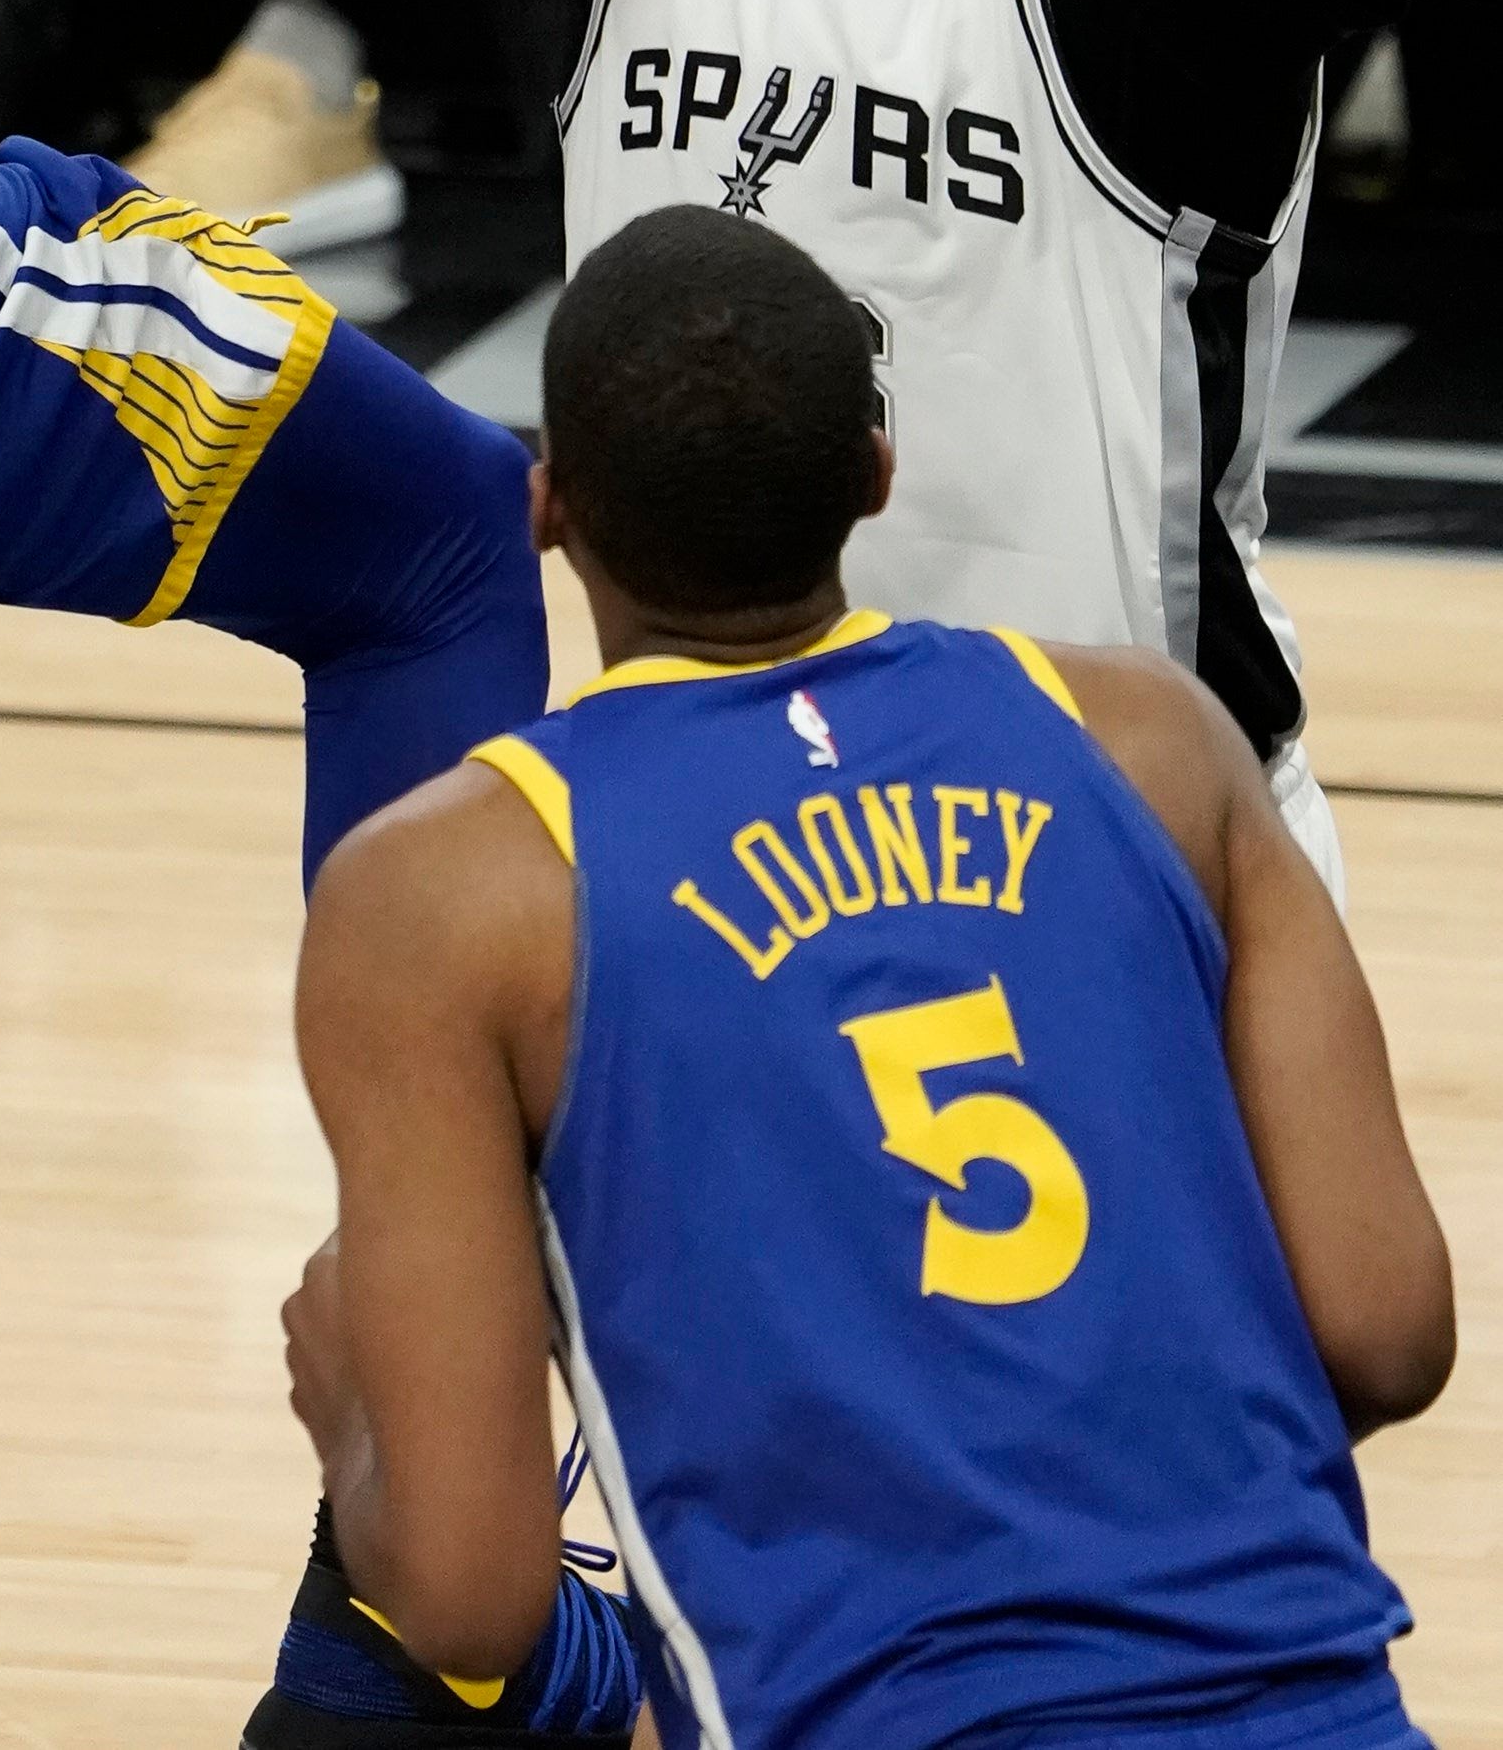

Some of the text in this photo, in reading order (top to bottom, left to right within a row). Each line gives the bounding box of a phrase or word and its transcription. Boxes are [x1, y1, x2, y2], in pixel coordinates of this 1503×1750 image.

[619, 48, 1025, 225] SPURS
[672, 782, 1053, 981] LOONEY
[838, 973, 1090, 1305] 5
